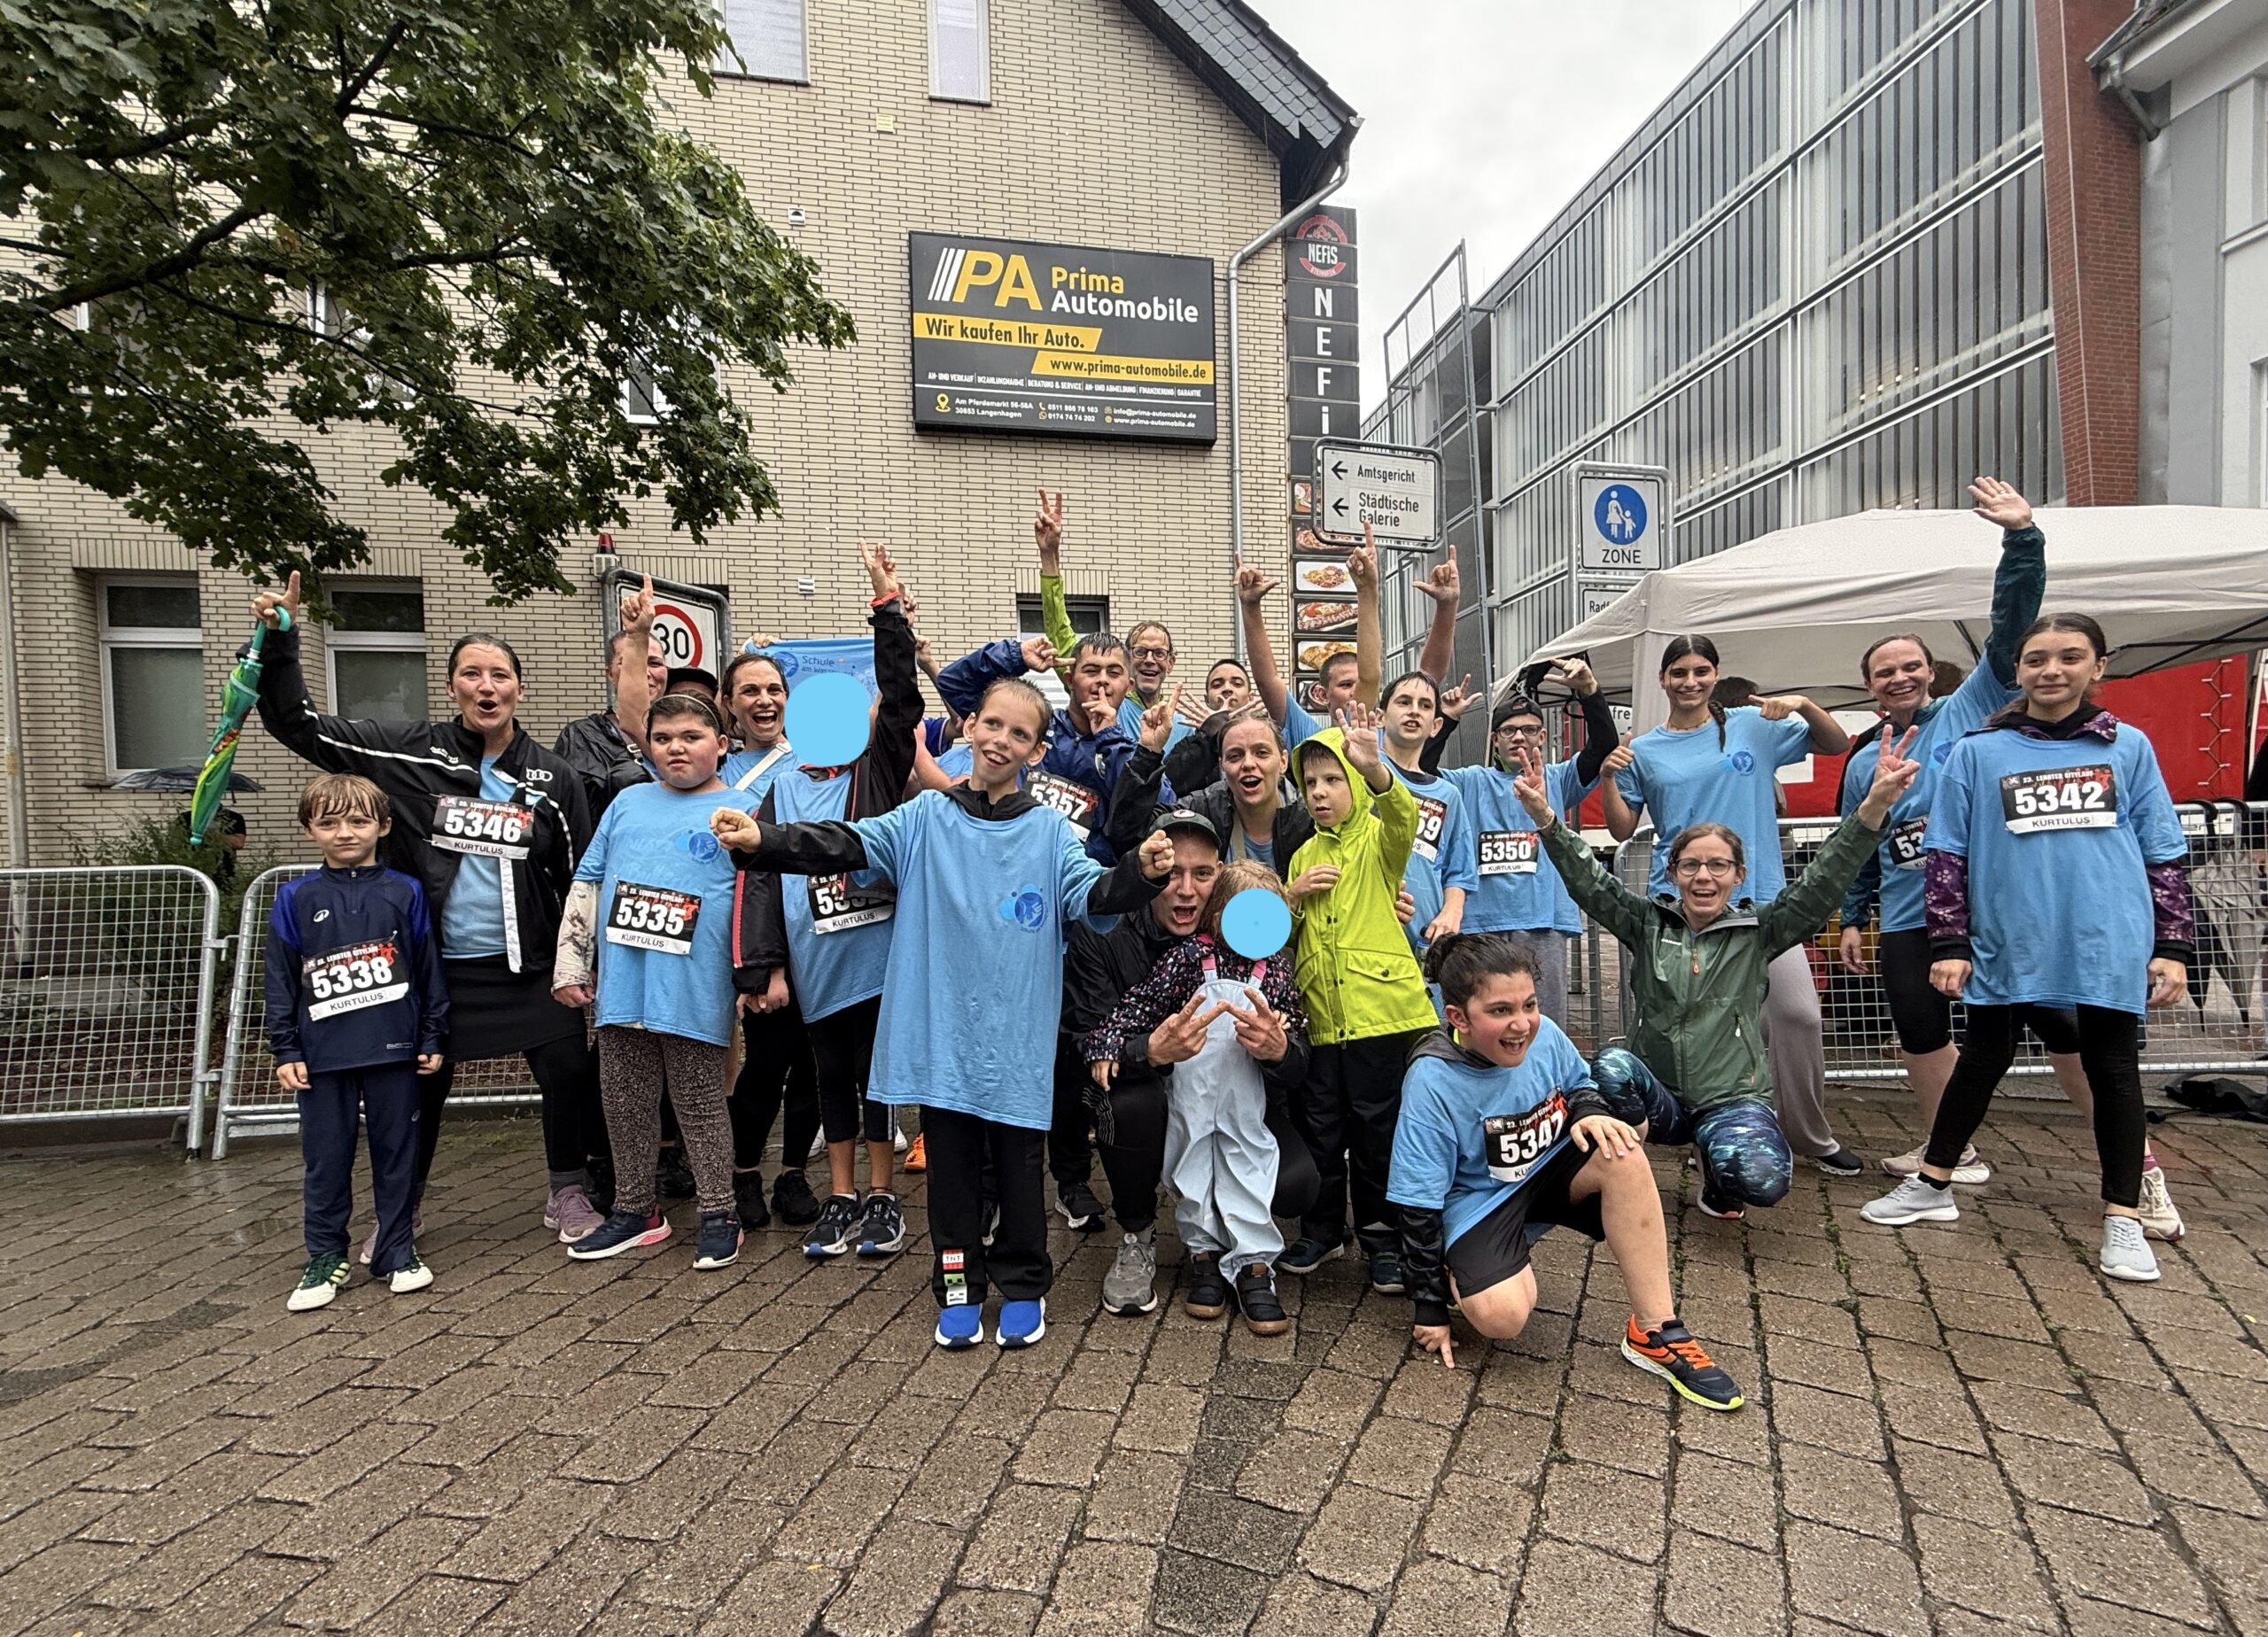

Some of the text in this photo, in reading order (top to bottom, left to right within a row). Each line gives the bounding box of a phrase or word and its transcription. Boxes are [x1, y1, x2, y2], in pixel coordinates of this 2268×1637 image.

[952, 249, 1043, 311] PA
[1052, 266, 1124, 294] Prima
[1051, 290, 1199, 322] Automobile
[926, 317, 1084, 348] Wir kaufen Ihr Auto.
[1050, 360, 1206, 378] www.prima-automobile.de
[950, 374, 975, 383] VERKAUF
[1177, 388, 1201, 397] GARANTIE
[968, 399, 1009, 407] Pferdemarkt
[1114, 407, 1197, 419] info@prima-automobile.de
[976, 408, 1022, 419] Langenhagen
[1114, 417, 1195, 428] www.prima-automobile.de
[1357, 464, 1416, 484] Amtsgericht
[1358, 492, 1419, 513] Städtische
[1358, 508, 1400, 527] Galerie
[1602, 548, 1642, 564] ZONE
[653, 623, 689, 660] 30
[802, 656, 835, 667] Schule
[1612, 706, 1631, 720] fre
[1030, 783, 1088, 820] 5357
[2015, 780, 2105, 815] 5342
[444, 808, 523, 842] 5346
[2032, 816, 2091, 827] KURTULUS
[454, 842, 503, 855] KURTULUS
[1480, 841, 1531, 862] 5350
[1895, 831, 1924, 858] 53
[616, 897, 687, 935] 5335
[832, 912, 875, 927] KURTULUS
[621, 934, 664, 948] KURTULUS
[311, 956, 392, 998] 5338
[330, 992, 384, 1011] KURTULUS
